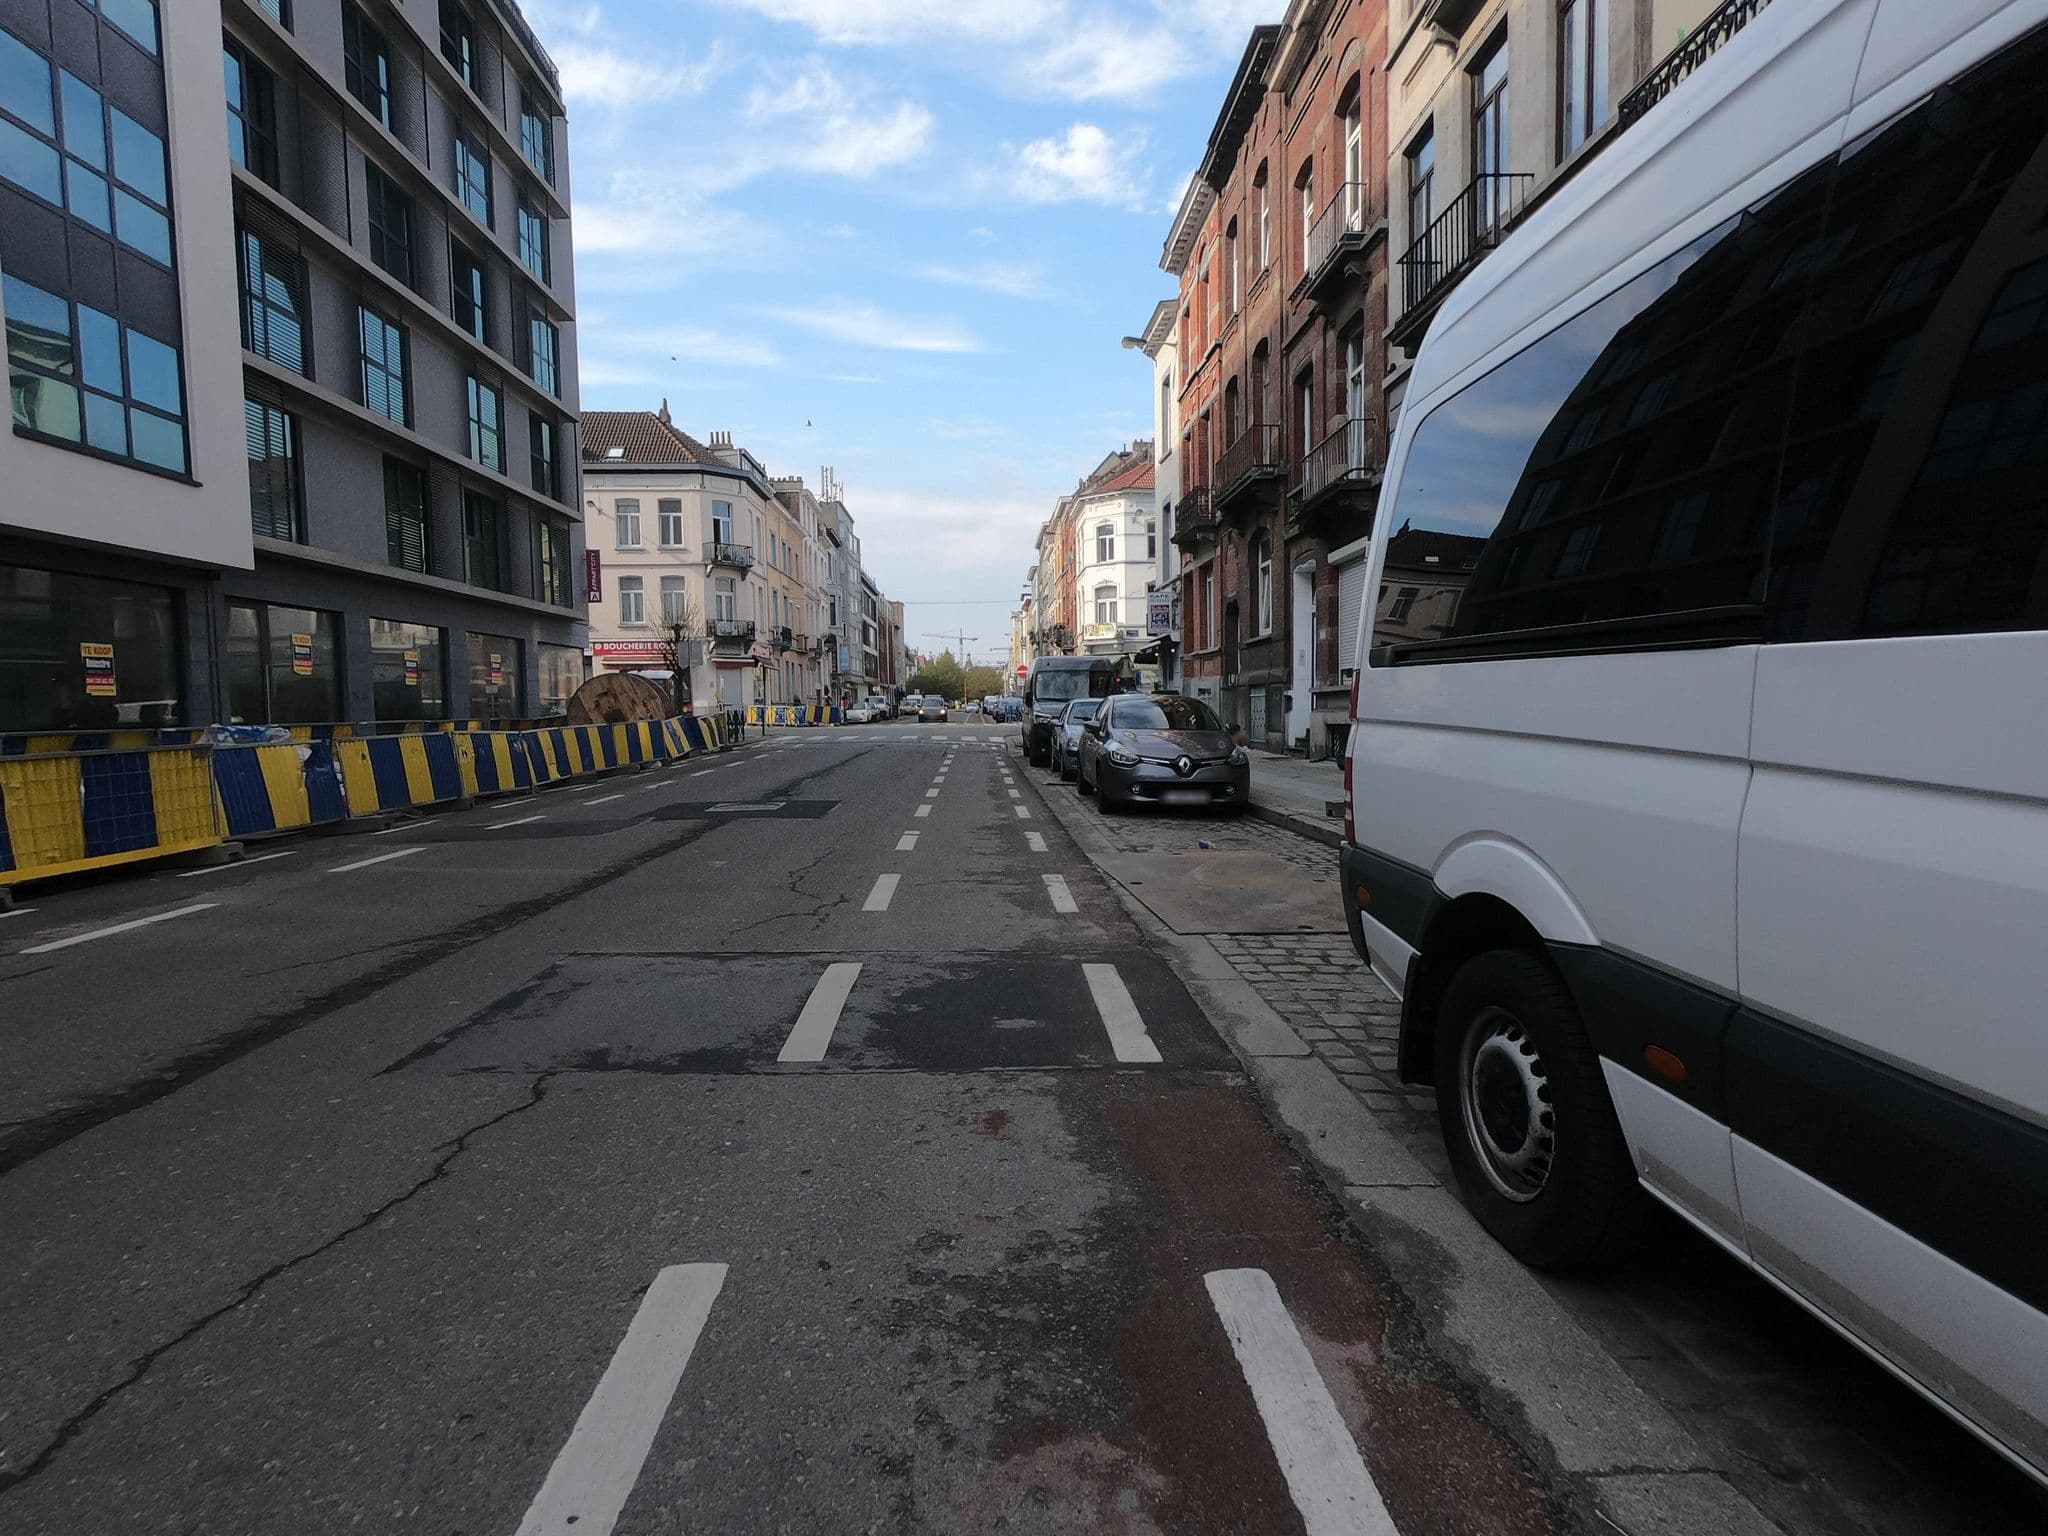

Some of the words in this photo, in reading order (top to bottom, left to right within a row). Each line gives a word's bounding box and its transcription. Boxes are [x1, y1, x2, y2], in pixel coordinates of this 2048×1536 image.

[603, 642, 652, 650] BOUCHERIE
[84, 646, 92, 655] TE
[93, 647, 112, 655] KOOP
